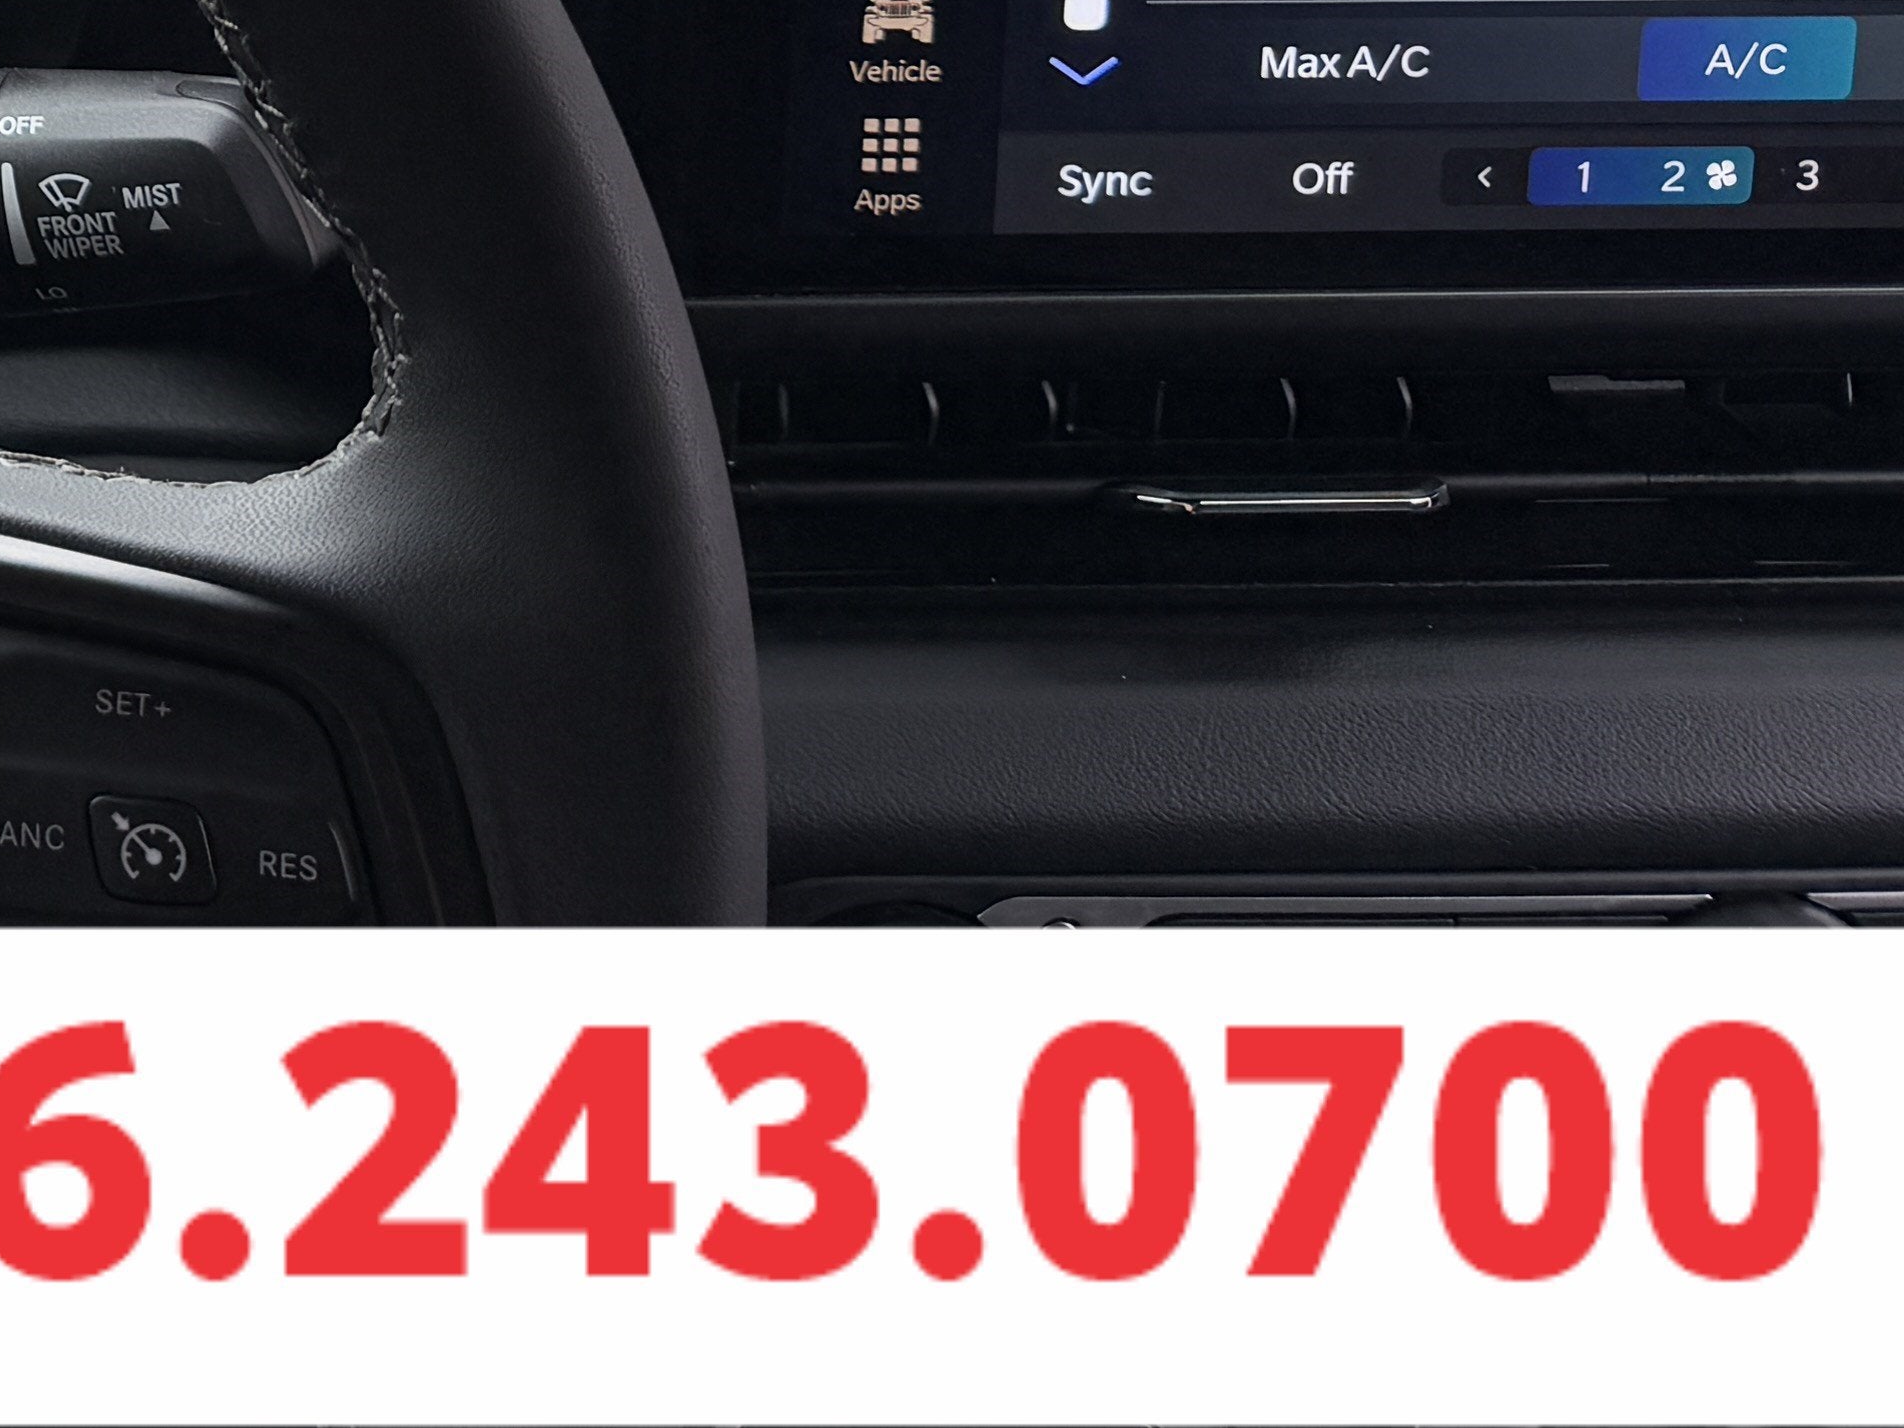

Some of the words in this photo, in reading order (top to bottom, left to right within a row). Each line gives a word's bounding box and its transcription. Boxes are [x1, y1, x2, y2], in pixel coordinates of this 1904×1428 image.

[849, 59, 942, 84] Vehicle
[1260, 46, 1340, 79] Max
[1347, 44, 1431, 81] A/C
[1705, 42, 1788, 78] A/C
[1058, 164, 1153, 204] Sync
[1292, 162, 1354, 196] Off
[1576, 162, 1592, 192] 1
[1661, 161, 1685, 192] 2
[1795, 160, 1820, 190] 3
[122, 183, 181, 210] MIST
[854, 190, 922, 216] Apps
[37, 211, 117, 237] FRONT
[44, 234, 124, 261] WIPER
[95, 689, 172, 718] SET+
[259, 850, 318, 882] RES
